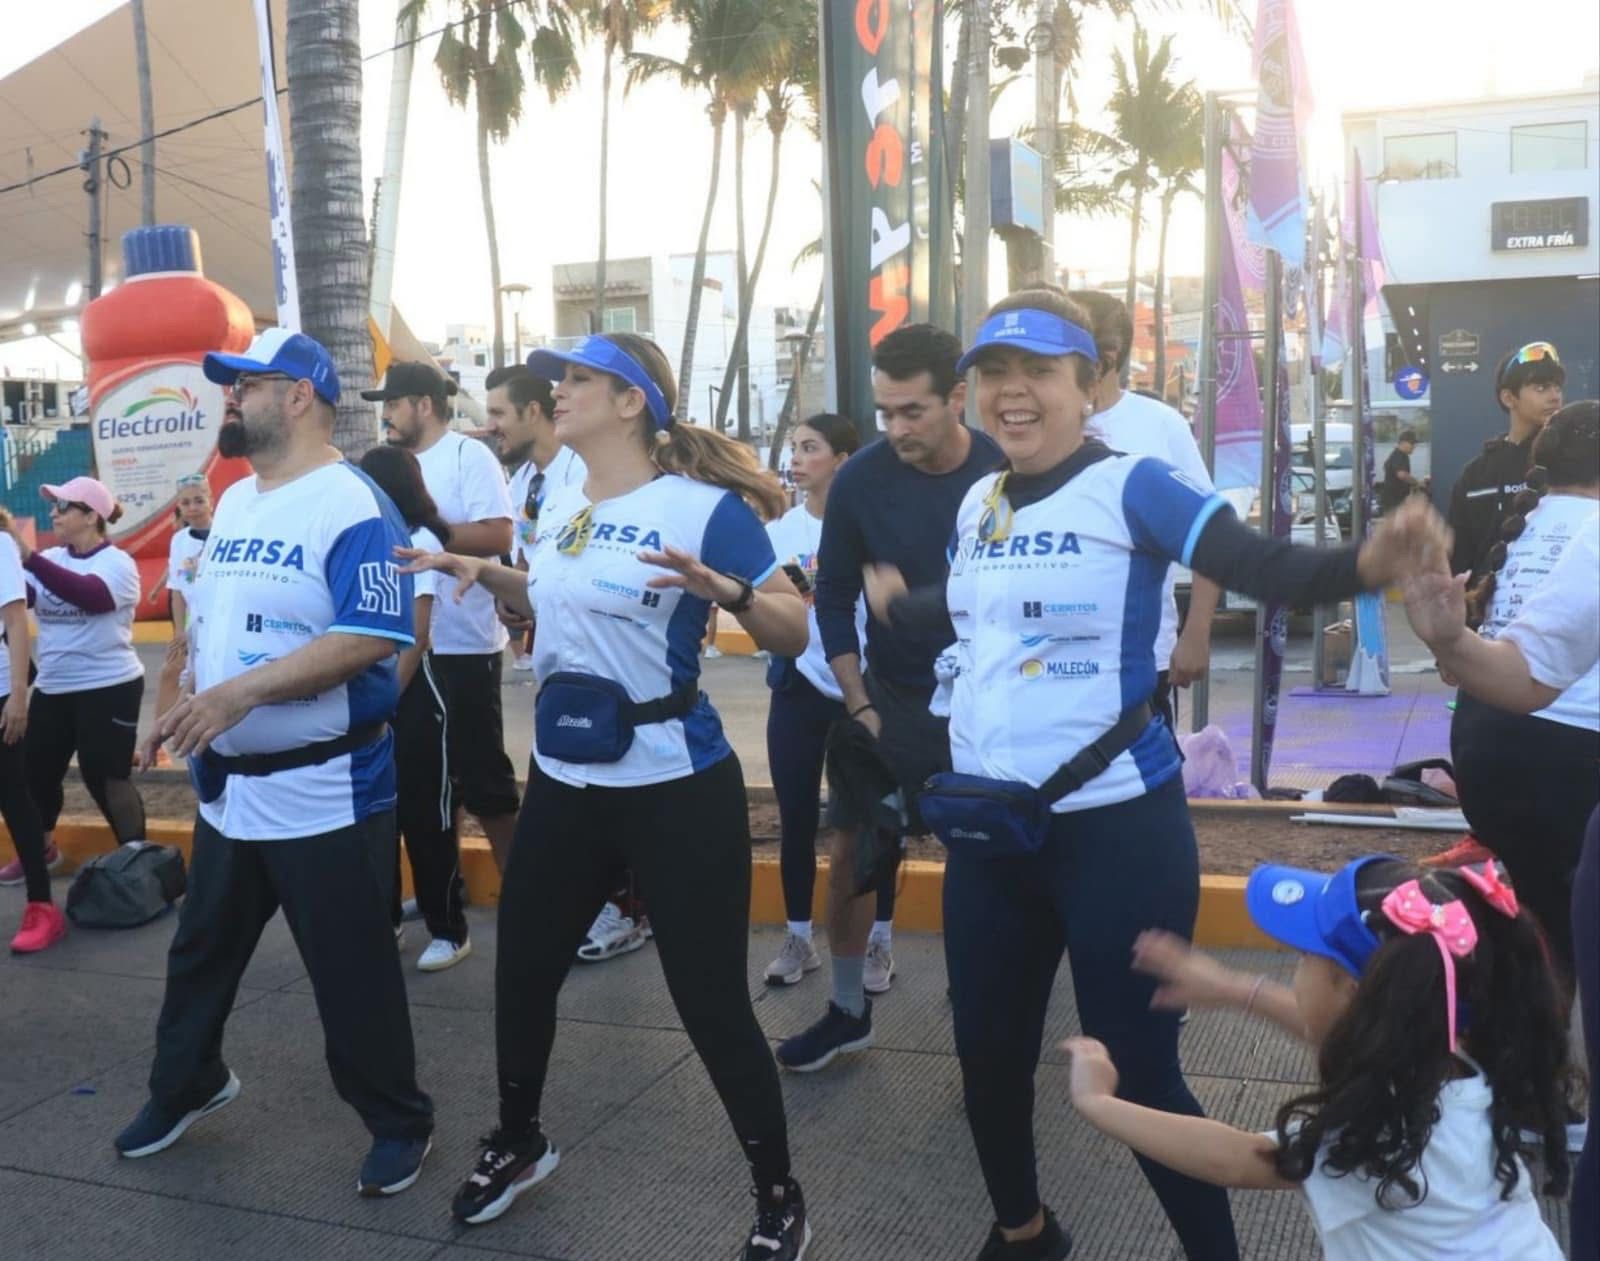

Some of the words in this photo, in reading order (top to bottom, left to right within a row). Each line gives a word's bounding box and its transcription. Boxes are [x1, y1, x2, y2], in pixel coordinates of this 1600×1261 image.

[1506, 235, 1544, 248] EXTRA
[1547, 231, 1574, 247] FRÍA
[98, 410, 207, 440] Electrolit
[211, 538, 304, 571] HERSA
[970, 531, 1082, 561] HERSA
[591, 578, 641, 598] CERRITOS
[1043, 603, 1099, 613] CERRITOS
[1047, 659, 1100, 675] MALECÓN
